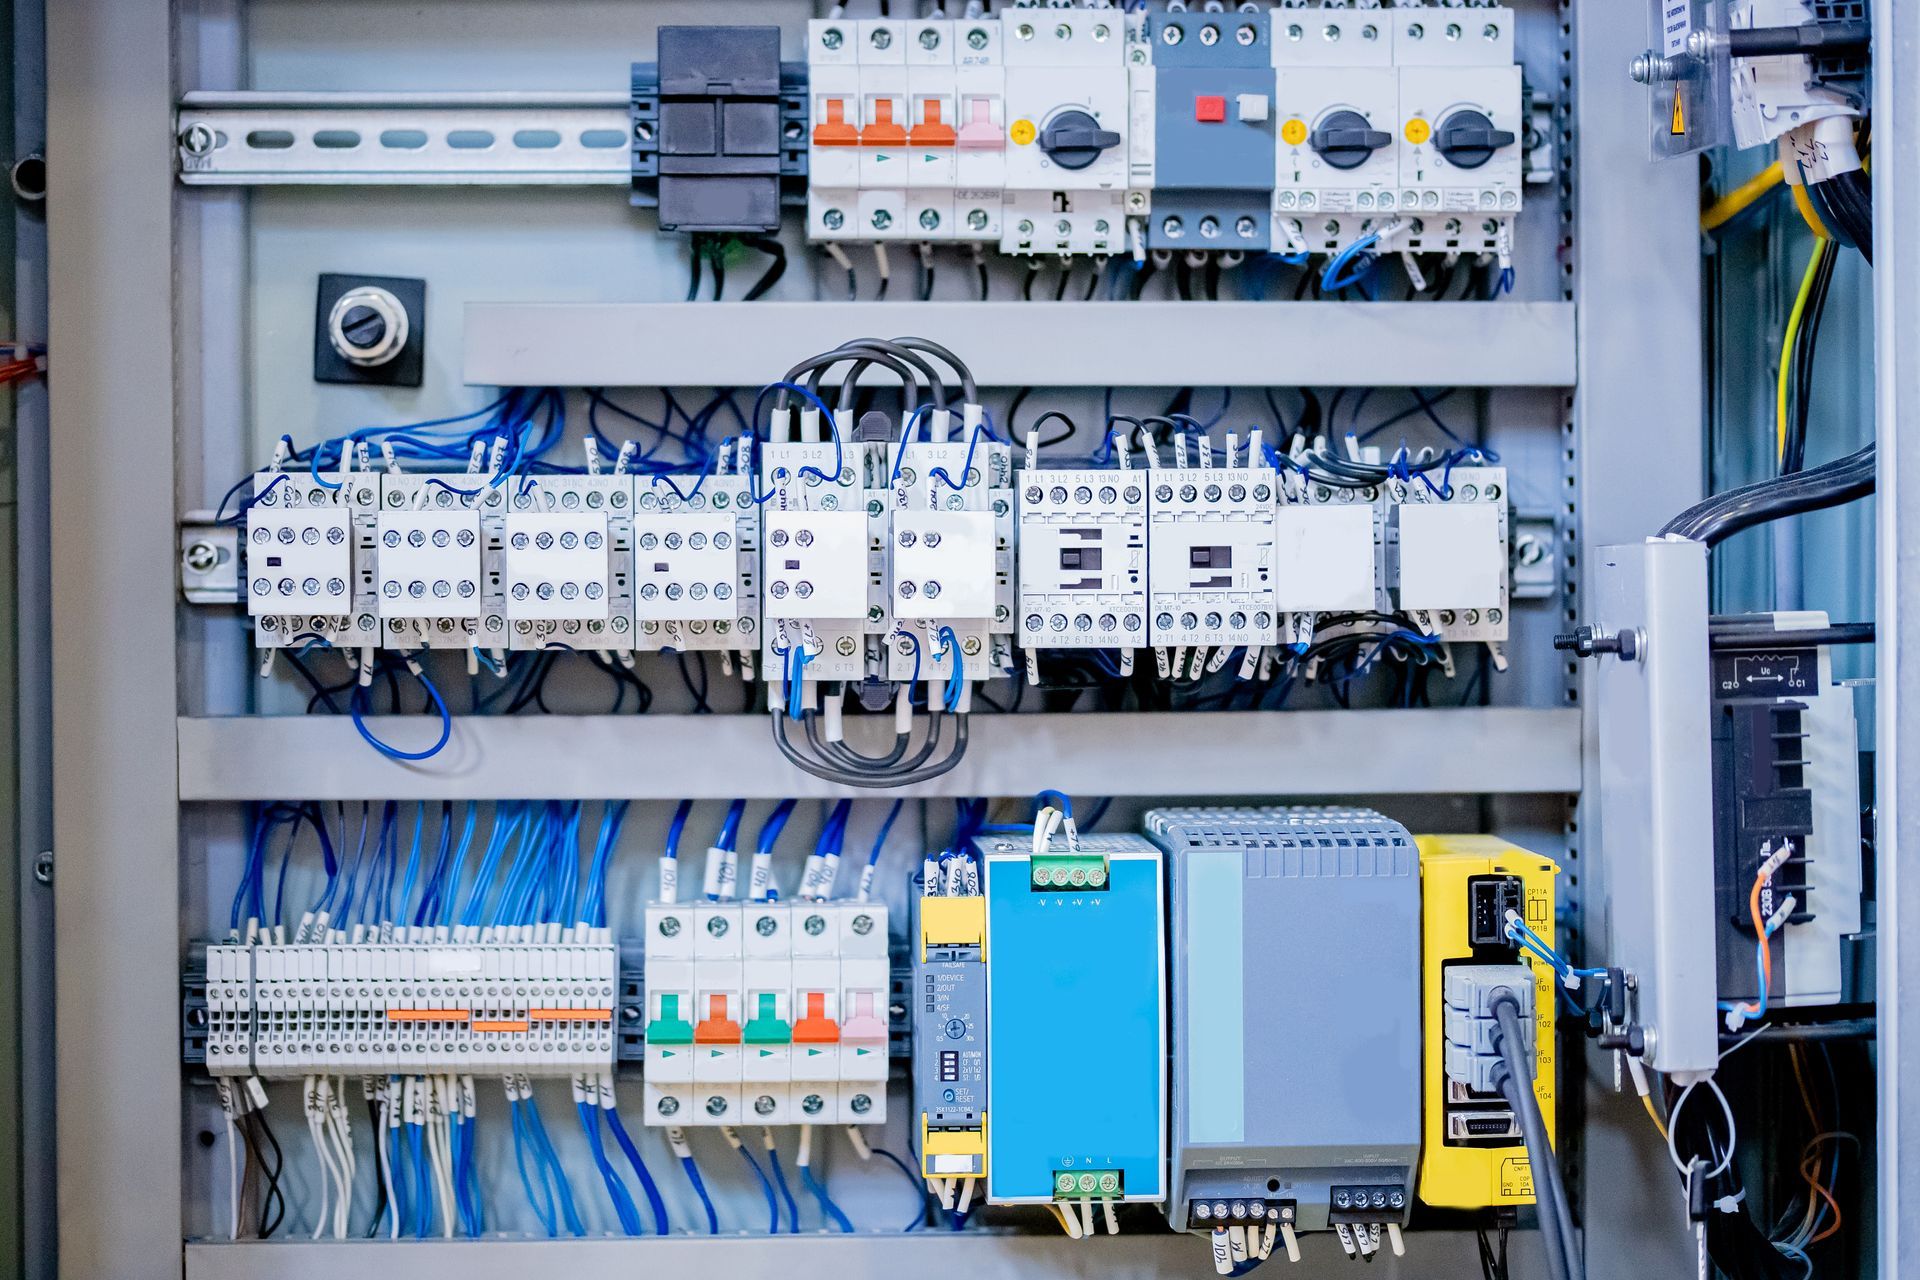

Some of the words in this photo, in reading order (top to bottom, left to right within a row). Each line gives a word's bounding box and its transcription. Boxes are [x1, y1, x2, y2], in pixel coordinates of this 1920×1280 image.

[740, 446, 751, 473] 308
[771, 450, 775, 460] 1
[780, 450, 790, 460] L1
[802, 450, 808, 460] 3
[811, 450, 823, 460] L2
[843, 450, 855, 460] L3
[905, 450, 915, 460] L1
[928, 450, 934, 460] 3
[937, 450, 948, 460] L2
[1026, 474, 1031, 484] 1
[1035, 474, 1044, 484] L1
[1050, 474, 1056, 484] 3
[1058, 474, 1068, 484] L2
[1075, 474, 1081, 484] 5
[1084, 474, 1095, 484] L3
[1132, 474, 1142, 484] A1
[1156, 472, 1160, 482] 1
[1164, 472, 1173, 482] L1
[1179, 472, 1185, 482] 3
[1187, 472, 1197, 482] L2
[1204, 472, 1210, 482] 5
[1213, 472, 1223, 482] L3
[1261, 472, 1271, 482] A1
[1026, 635, 1032, 644] 2
[1035, 635, 1044, 644] T1
[1051, 635, 1057, 644] 4
[1060, 635, 1070, 644] T2
[1075, 635, 1081, 644] 6
[1084, 635, 1094, 644] T3
[1131, 635, 1142, 644] A2
[1157, 633, 1163, 642] 2
[1165, 633, 1174, 642] T1
[1181, 633, 1187, 642] 4
[1190, 633, 1199, 642] T2
[1204, 633, 1210, 642] 6
[1214, 633, 1224, 642] T3
[1260, 633, 1271, 642] A2
[834, 663, 841, 672] 6
[844, 663, 855, 672] T3
[897, 663, 903, 672] 2
[969, 663, 980, 672] T3
[1760, 666, 1771, 675] Uc
[1722, 680, 1733, 690] C2
[1795, 679, 1806, 688] C1
[754, 865, 769, 887] 401
[1527, 888, 1548, 896] CP11A
[1071, 898, 1083, 907] +V
[1090, 898, 1101, 907] +V
[937, 974, 965, 982] 1/DEVICE
[936, 984, 956, 992] 2/OUT
[1539, 984, 1550, 992] 101
[936, 994, 950, 1002] 3/IN
[936, 1004, 951, 1012] 4/SF
[941, 1012, 948, 1020] 10
[963, 1012, 971, 1020] 20
[1085, 1156, 1092, 1164] N
[1107, 1156, 1112, 1164] L
[1215, 1242, 1227, 1264] 401
